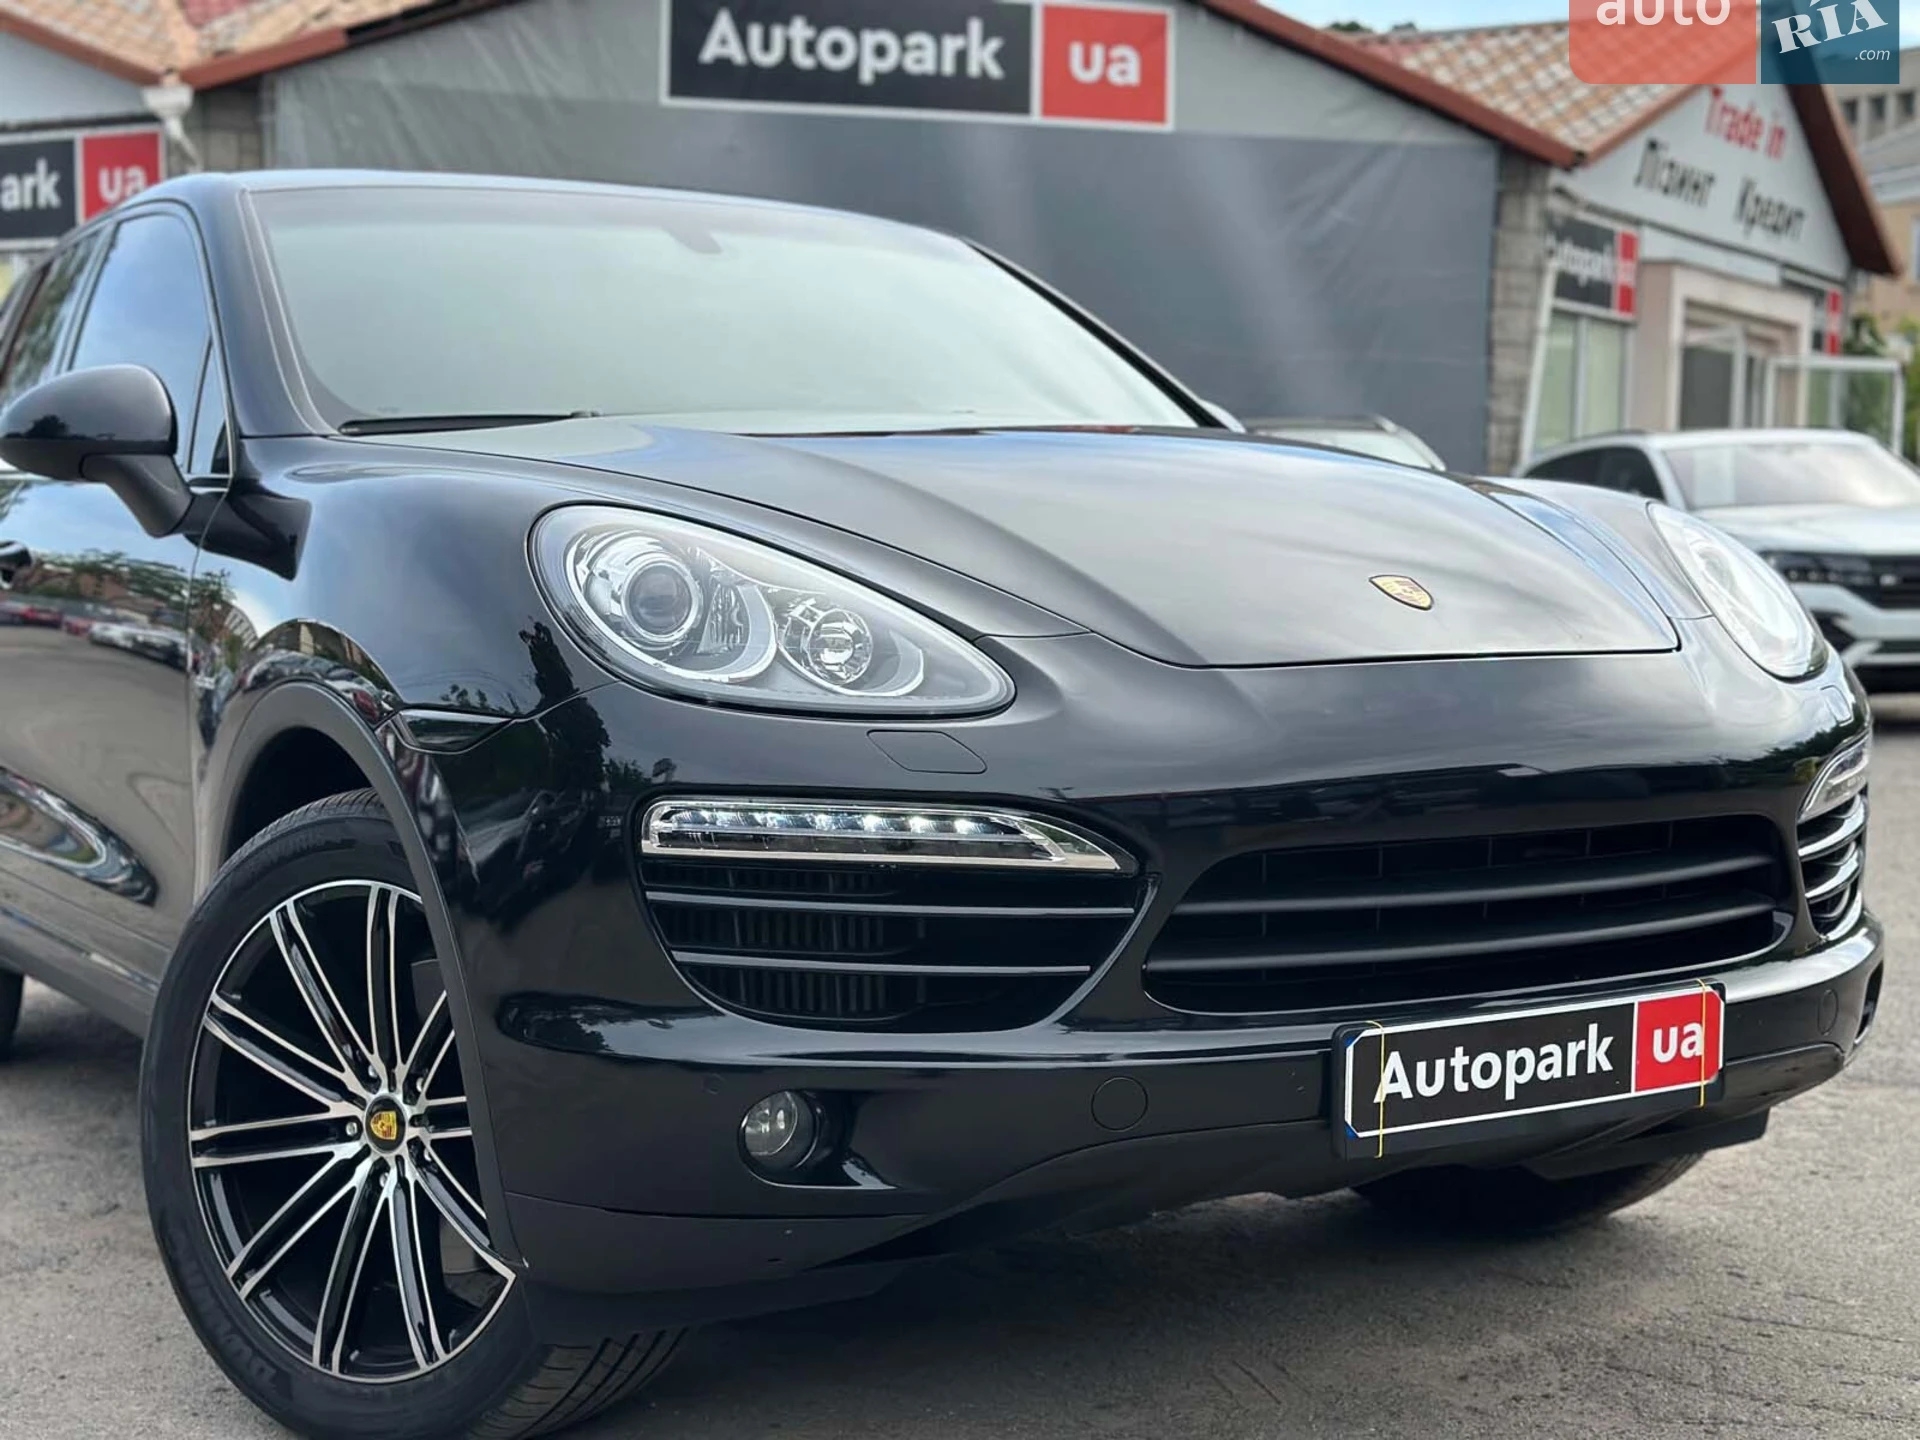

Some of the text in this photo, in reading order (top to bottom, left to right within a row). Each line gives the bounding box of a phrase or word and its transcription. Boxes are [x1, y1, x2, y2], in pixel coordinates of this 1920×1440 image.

[699, 8, 1141, 86] Autopark ua
[1704, 86, 1764, 151] Trade
[1734, 177, 1805, 239] Кредит
[1374, 1021, 1705, 1103] Autopark ua
